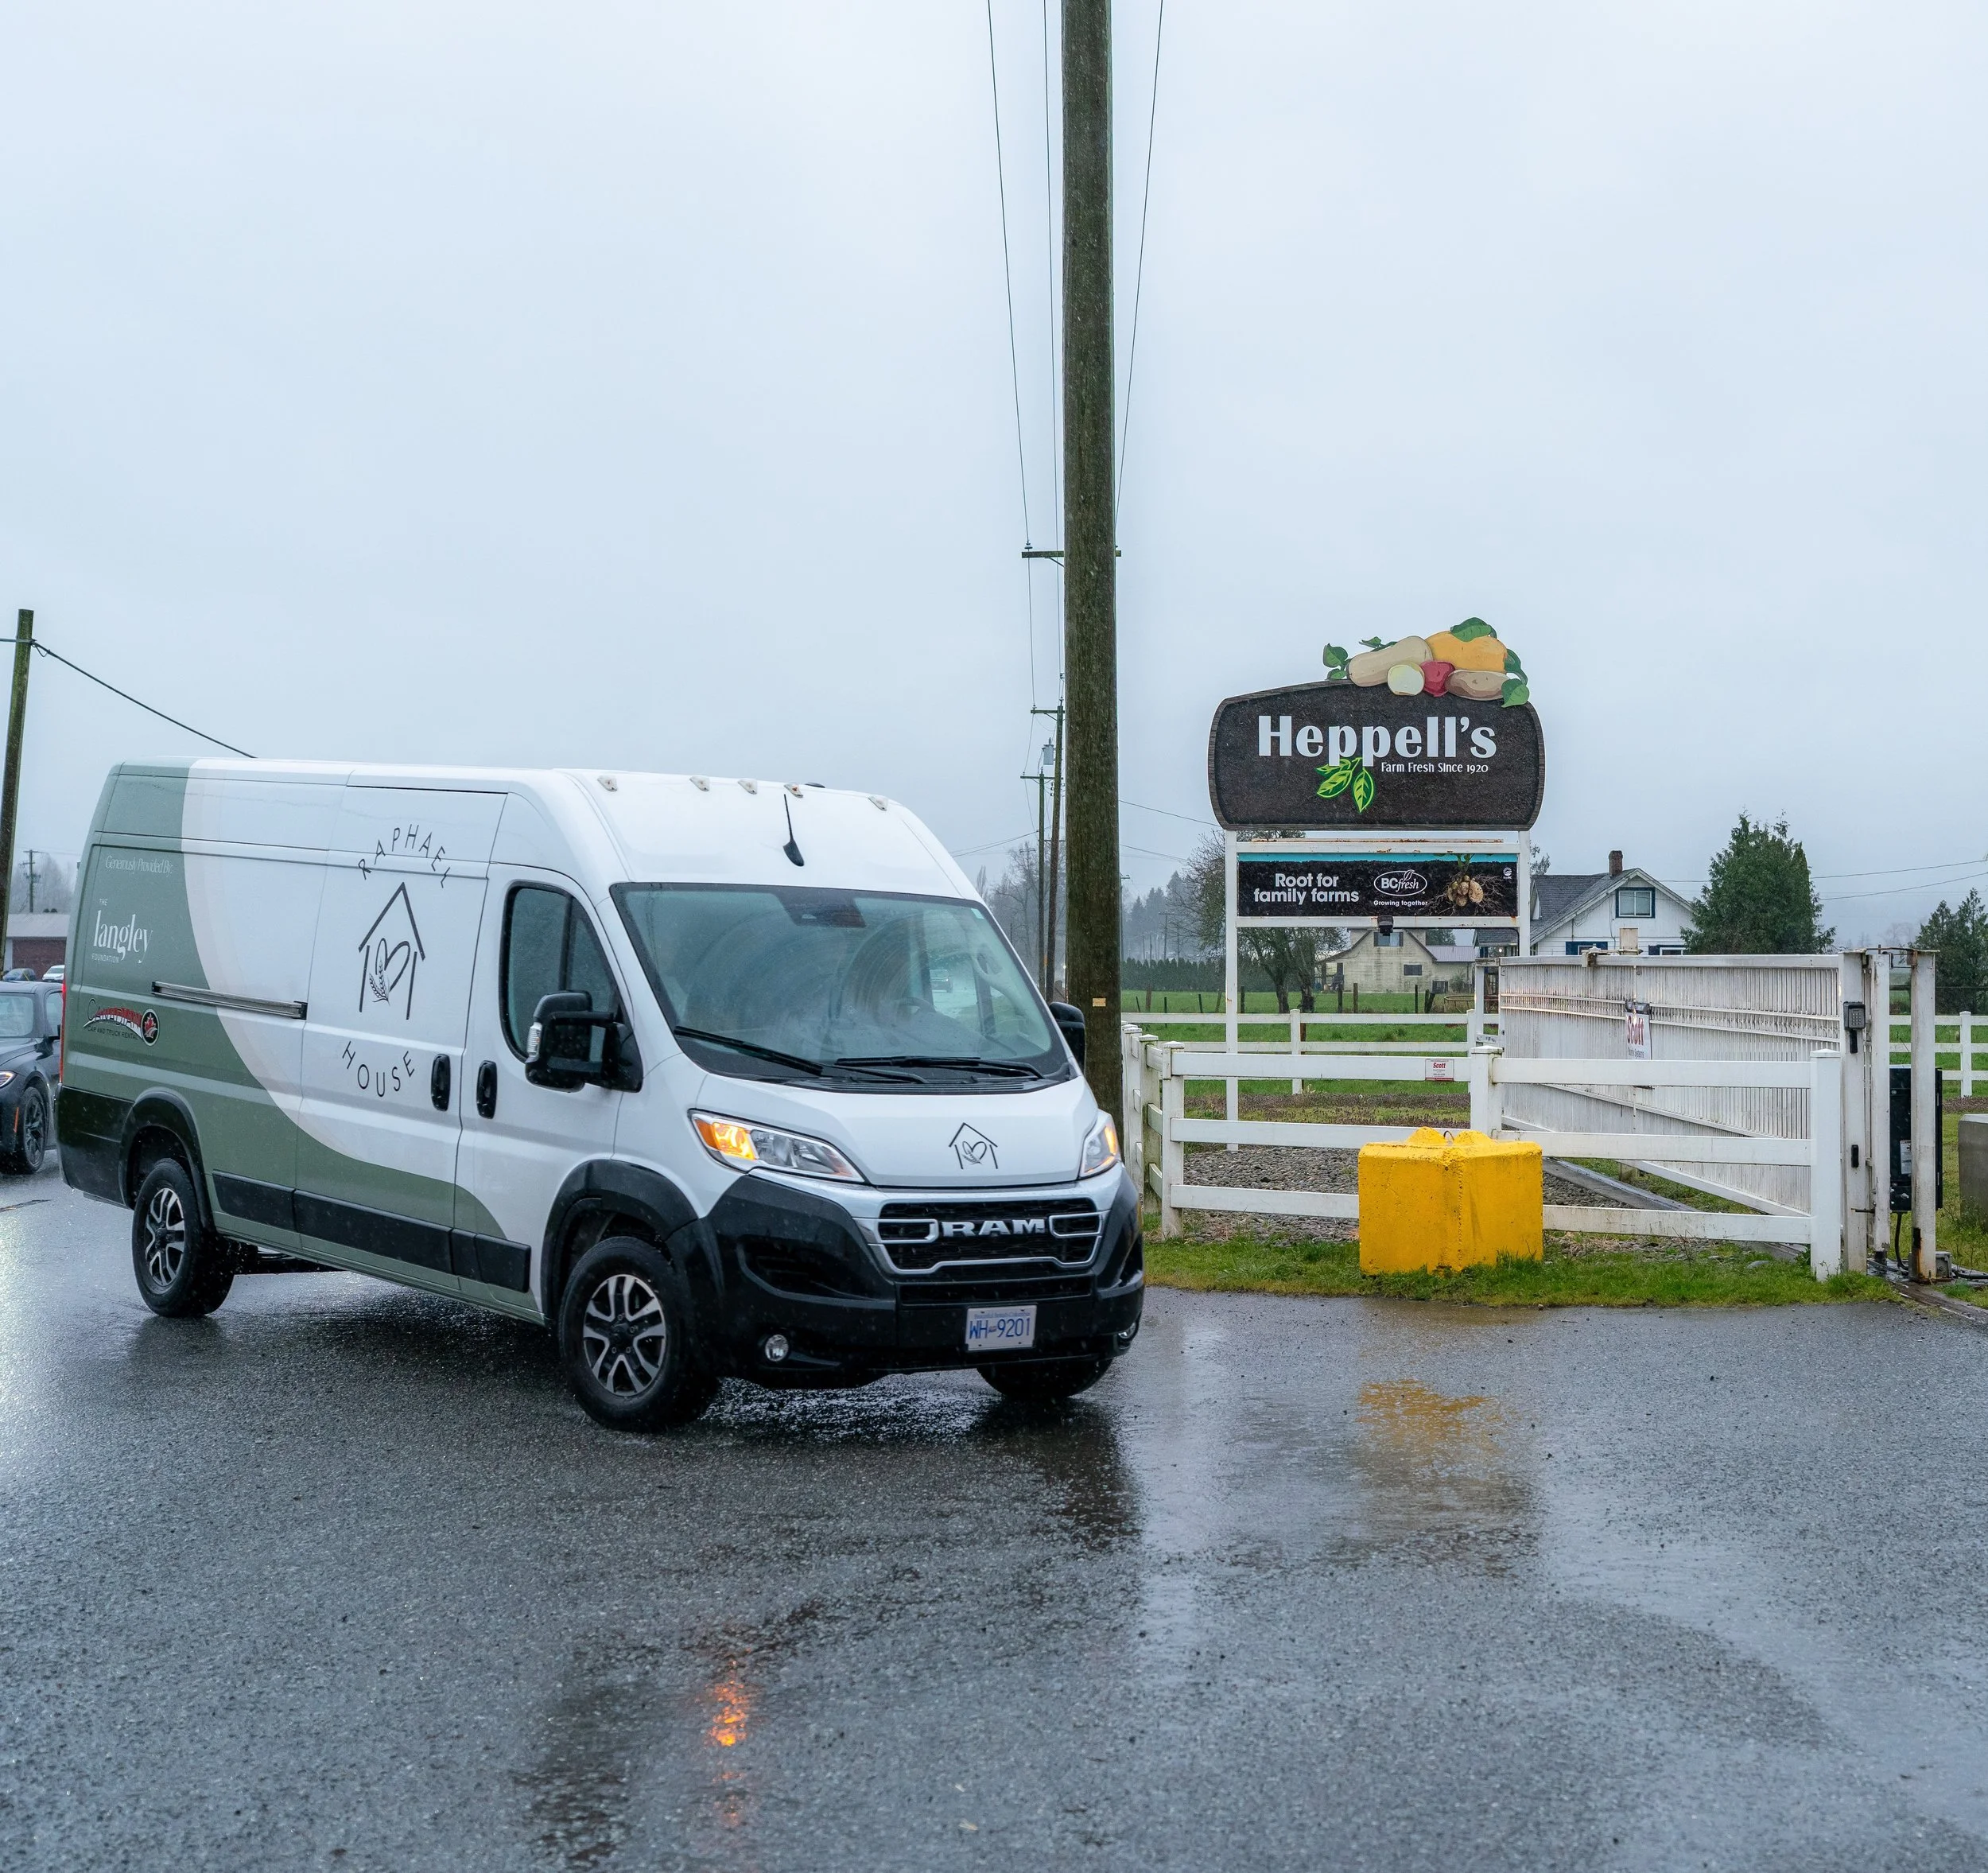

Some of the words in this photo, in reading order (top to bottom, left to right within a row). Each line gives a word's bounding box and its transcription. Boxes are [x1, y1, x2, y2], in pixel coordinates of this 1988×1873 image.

[1258, 715, 1497, 767] Heppell's
[1380, 762, 1405, 772] Farm
[1408, 762, 1435, 772] Fresh
[1466, 764, 1489, 775] 1920
[105, 855, 136, 875] Generously
[137, 857, 164, 873] Provided
[358, 823, 451, 888] RAPHAEL
[1275, 872, 1314, 888] Root
[1316, 872, 1339, 888] for
[1380, 877, 1419, 892] BCfresh
[99, 897, 108, 907] THE
[1253, 888, 1307, 905] family
[1310, 888, 1360, 903] farms
[93, 910, 153, 964] langley
[91, 953, 120, 964] FOUNDATION
[1627, 1015, 1644, 1046] Scott
[341, 1040, 416, 1098] HOUSE
[941, 1218, 1046, 1238] RAM
